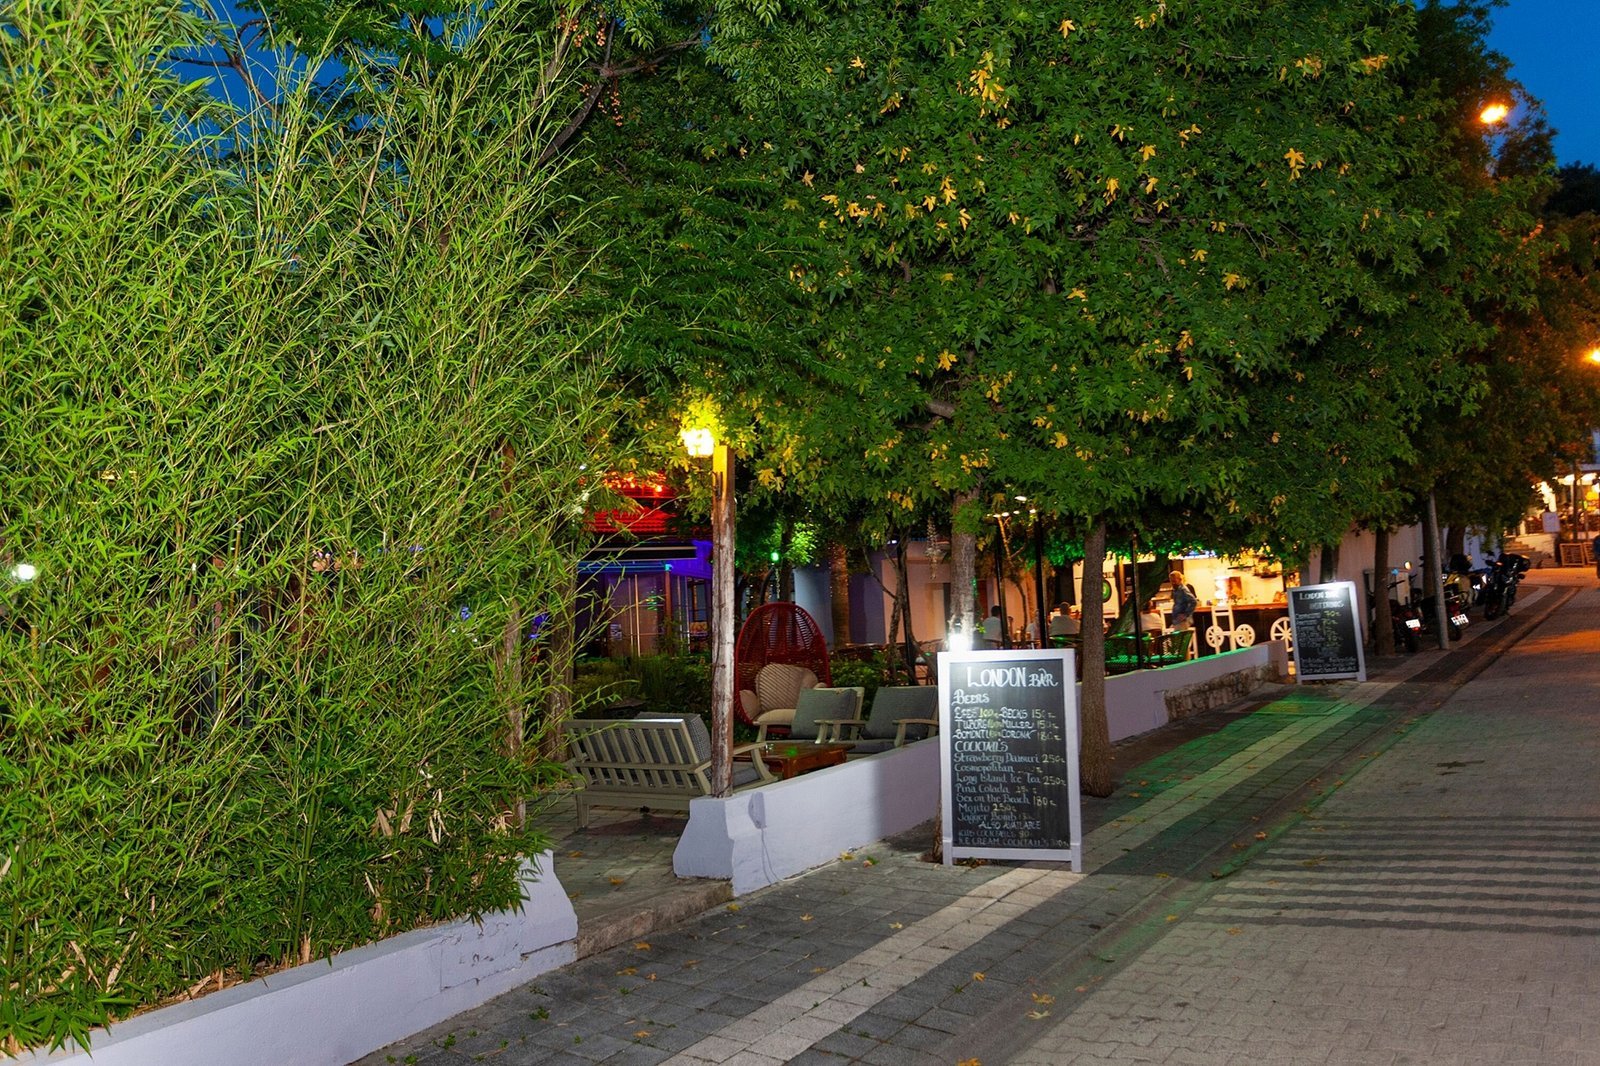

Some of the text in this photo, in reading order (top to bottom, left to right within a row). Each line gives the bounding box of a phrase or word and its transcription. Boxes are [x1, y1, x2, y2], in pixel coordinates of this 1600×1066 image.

[967, 666, 1058, 687] LONDON BAR
[954, 707, 979, 718] EFES
[1000, 707, 1028, 719] BECKS
[955, 720, 988, 730] TUBORG
[954, 741, 1008, 752] COCKTAILS
[954, 753, 1004, 763] Strawberry
[954, 762, 1015, 774] Cosmopolitan
[956, 773, 978, 785] Long
[980, 773, 1008, 783] Island
[979, 783, 1010, 794] Colada
[956, 793, 972, 803] Sex
[986, 794, 1001, 802] the
[1003, 794, 1030, 804] Beach
[958, 803, 990, 813] Mojito
[990, 812, 1017, 821] Bomb
[978, 821, 1002, 830] ALSO
